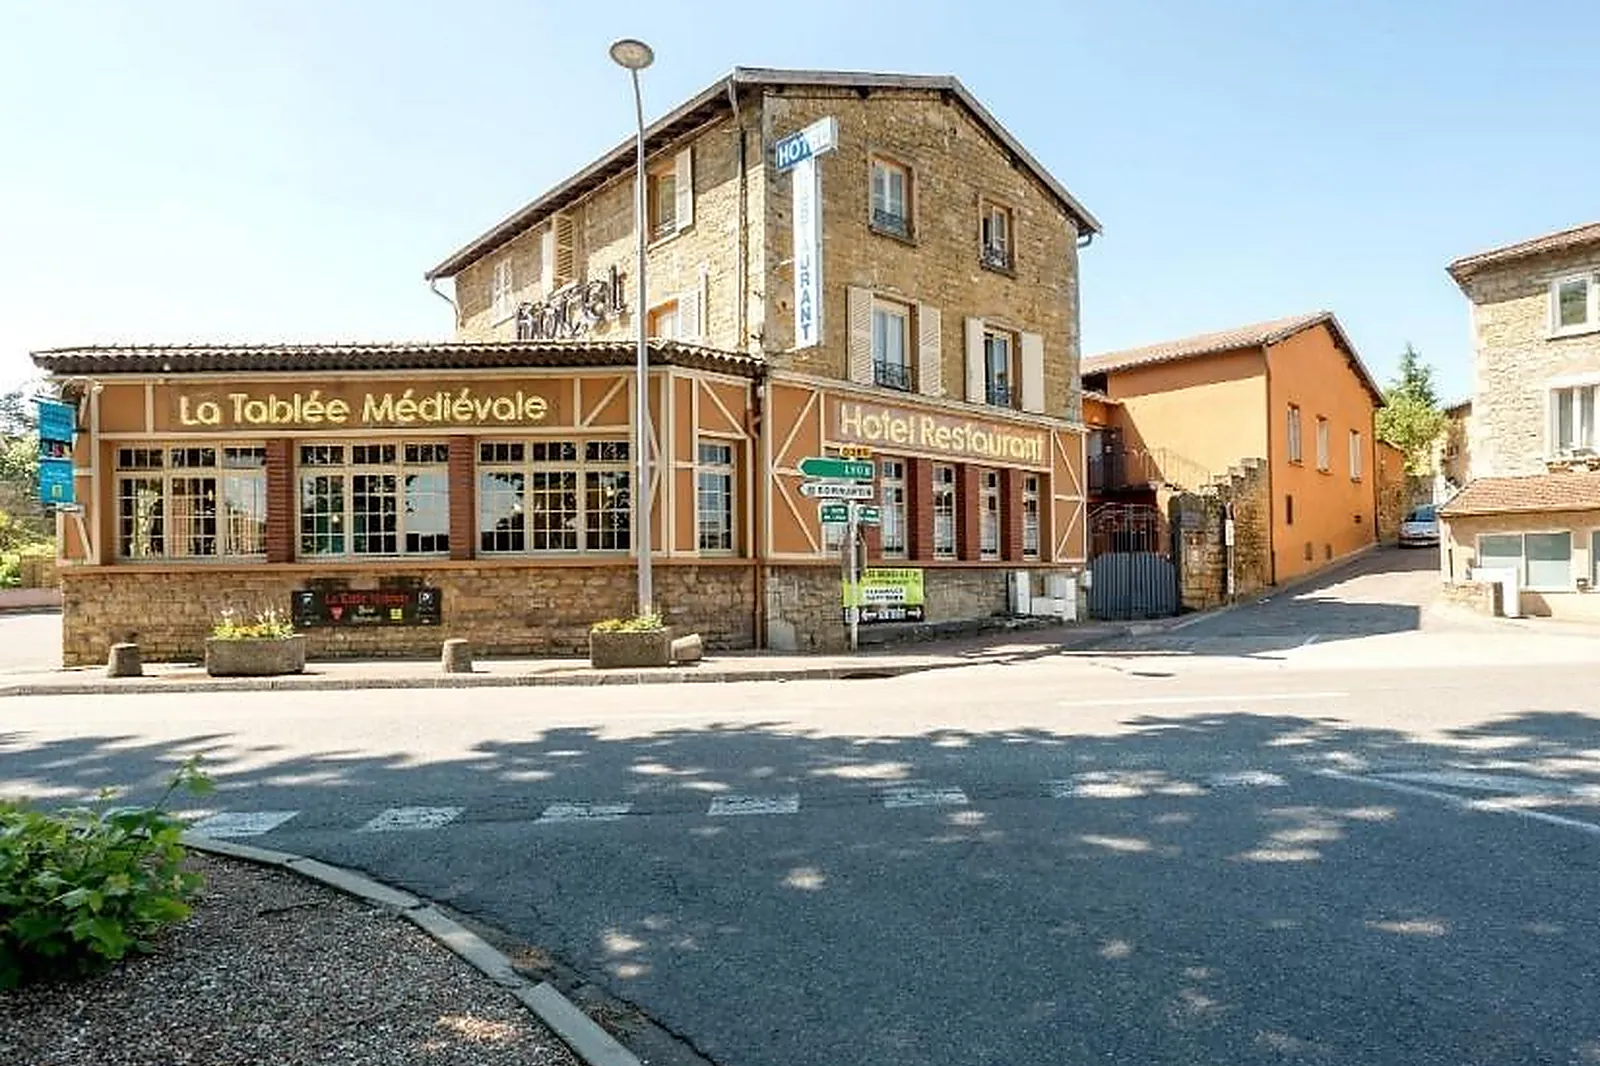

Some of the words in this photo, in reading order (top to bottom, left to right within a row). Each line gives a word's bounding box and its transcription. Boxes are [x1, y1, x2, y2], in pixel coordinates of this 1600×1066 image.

[180, 395, 220, 425] La
[229, 389, 350, 424] Tablée
[362, 387, 548, 425] Médiévale
[921, 415, 1045, 463] Restaurant
